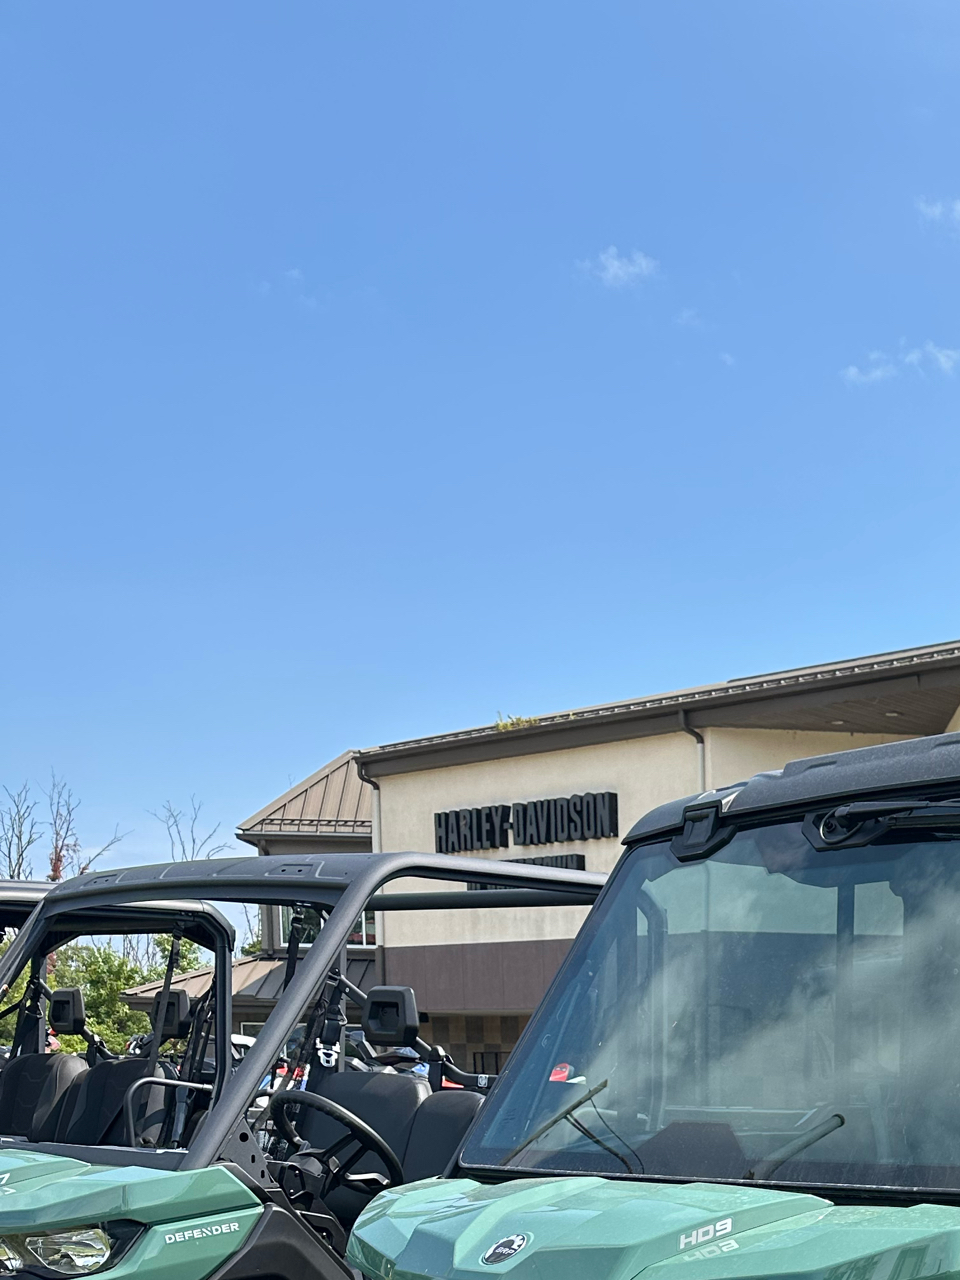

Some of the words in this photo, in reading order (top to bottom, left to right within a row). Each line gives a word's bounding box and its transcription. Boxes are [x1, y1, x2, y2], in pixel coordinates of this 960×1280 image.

[434, 792, 619, 853] HARLEY-DAVIDSON
[165, 1222, 240, 1244] DEFENDER
[679, 1217, 732, 1250] HD9
